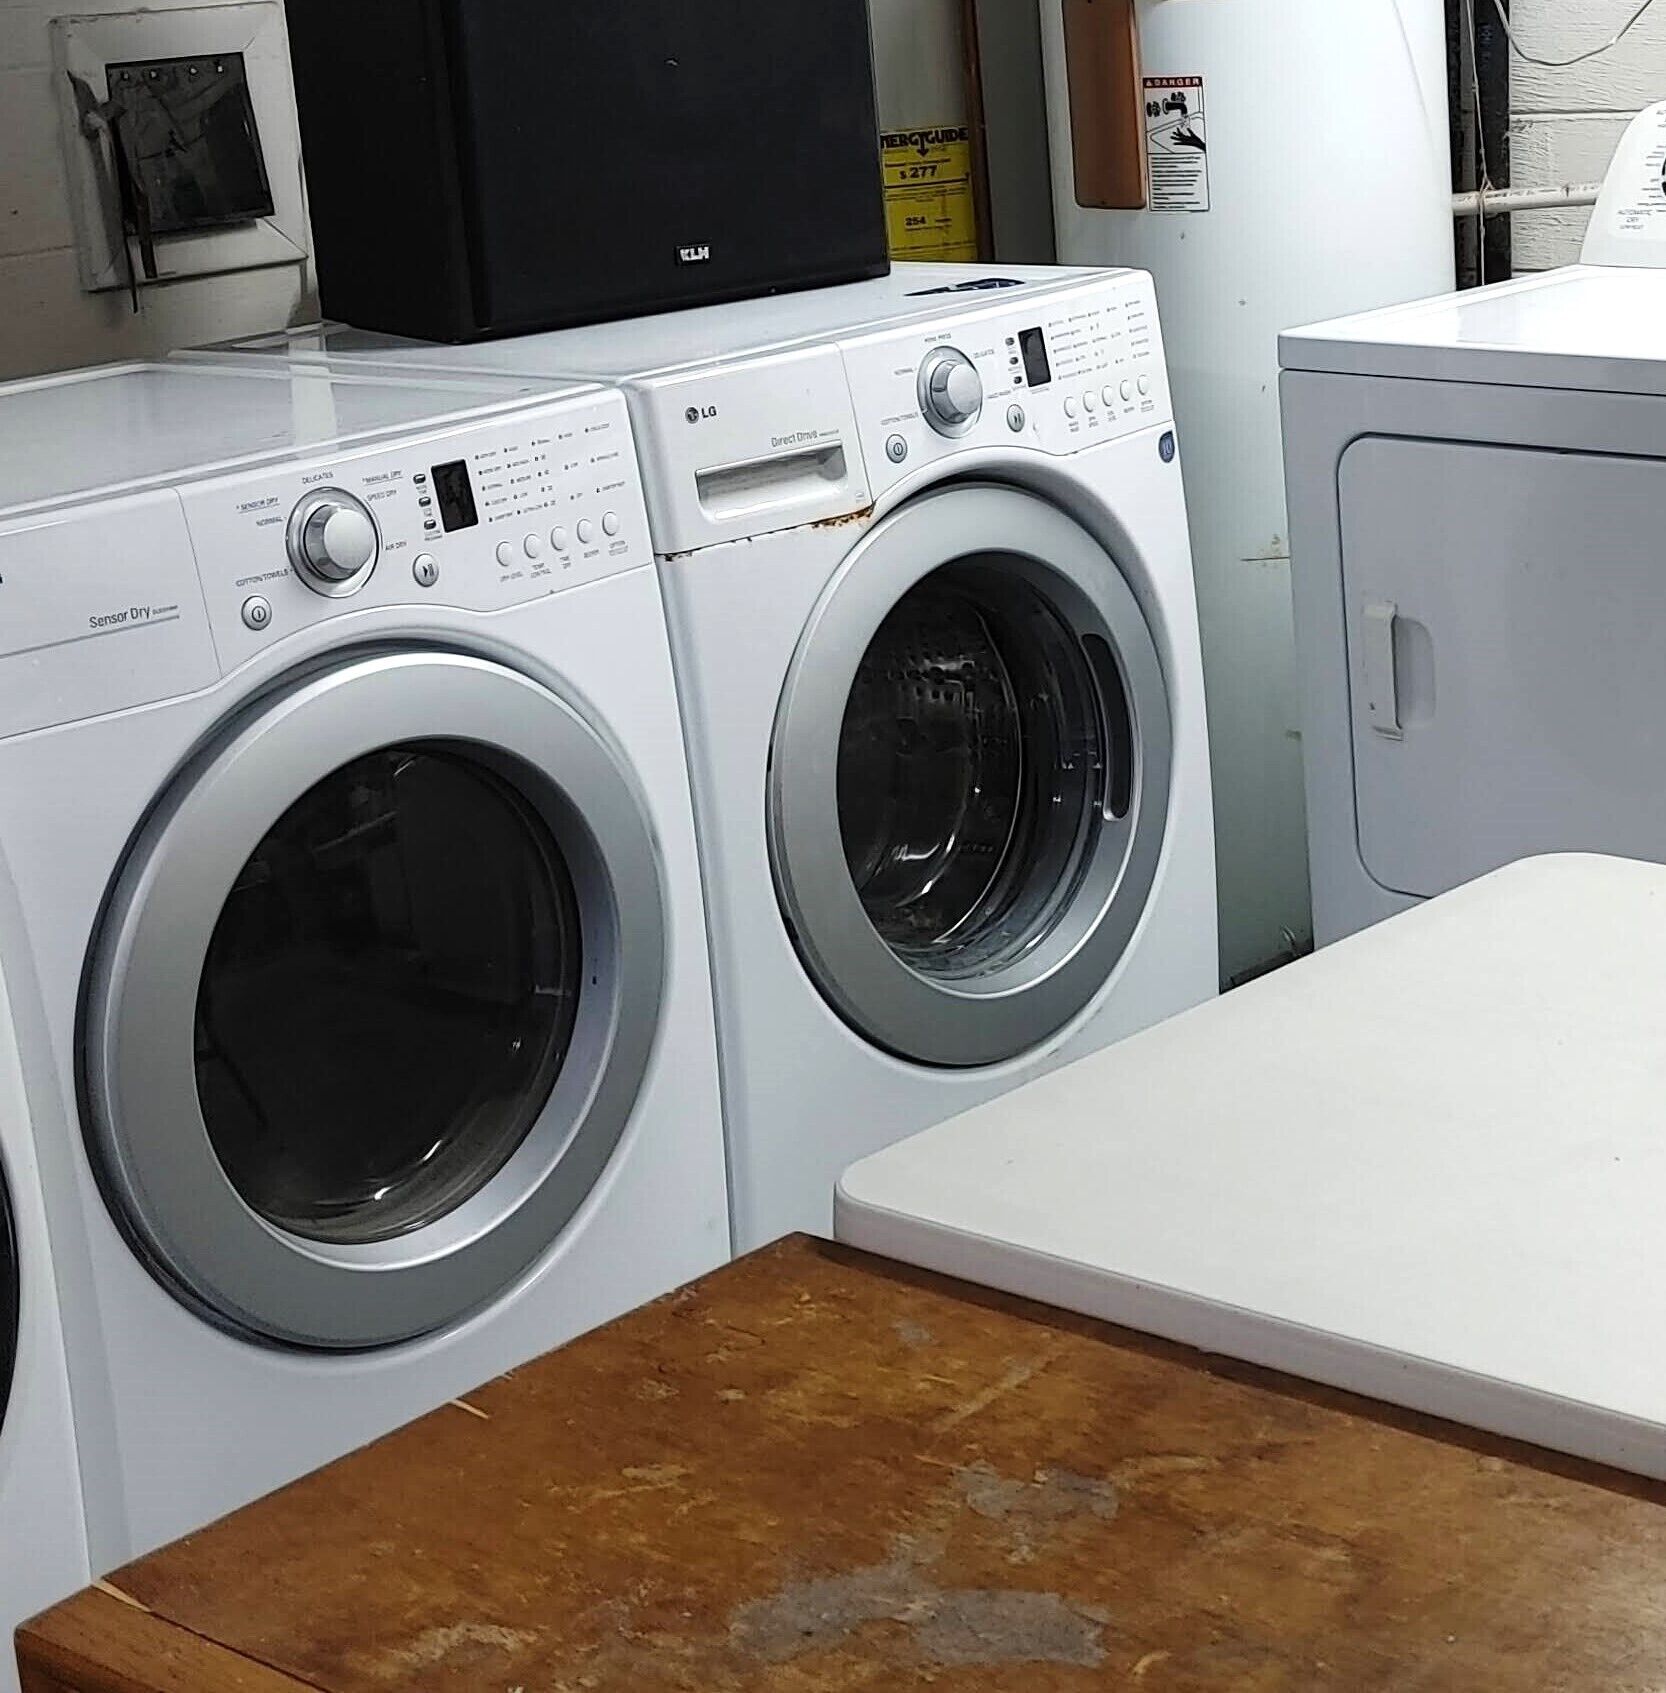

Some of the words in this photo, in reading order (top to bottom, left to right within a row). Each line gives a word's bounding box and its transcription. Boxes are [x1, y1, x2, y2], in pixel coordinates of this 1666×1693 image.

[1154, 79, 1200, 87] DANGER
[880, 128, 968, 149] NERGYGUIDE
[904, 216, 926, 227] 254
[680, 246, 709, 261] KLH
[701, 405, 717, 419] LG
[771, 434, 796, 447] Direct
[797, 429, 818, 442] Drive
[302, 471, 334, 484] DELICATES
[89, 611, 129, 629] Sensor
[130, 606, 150, 619] Dry
